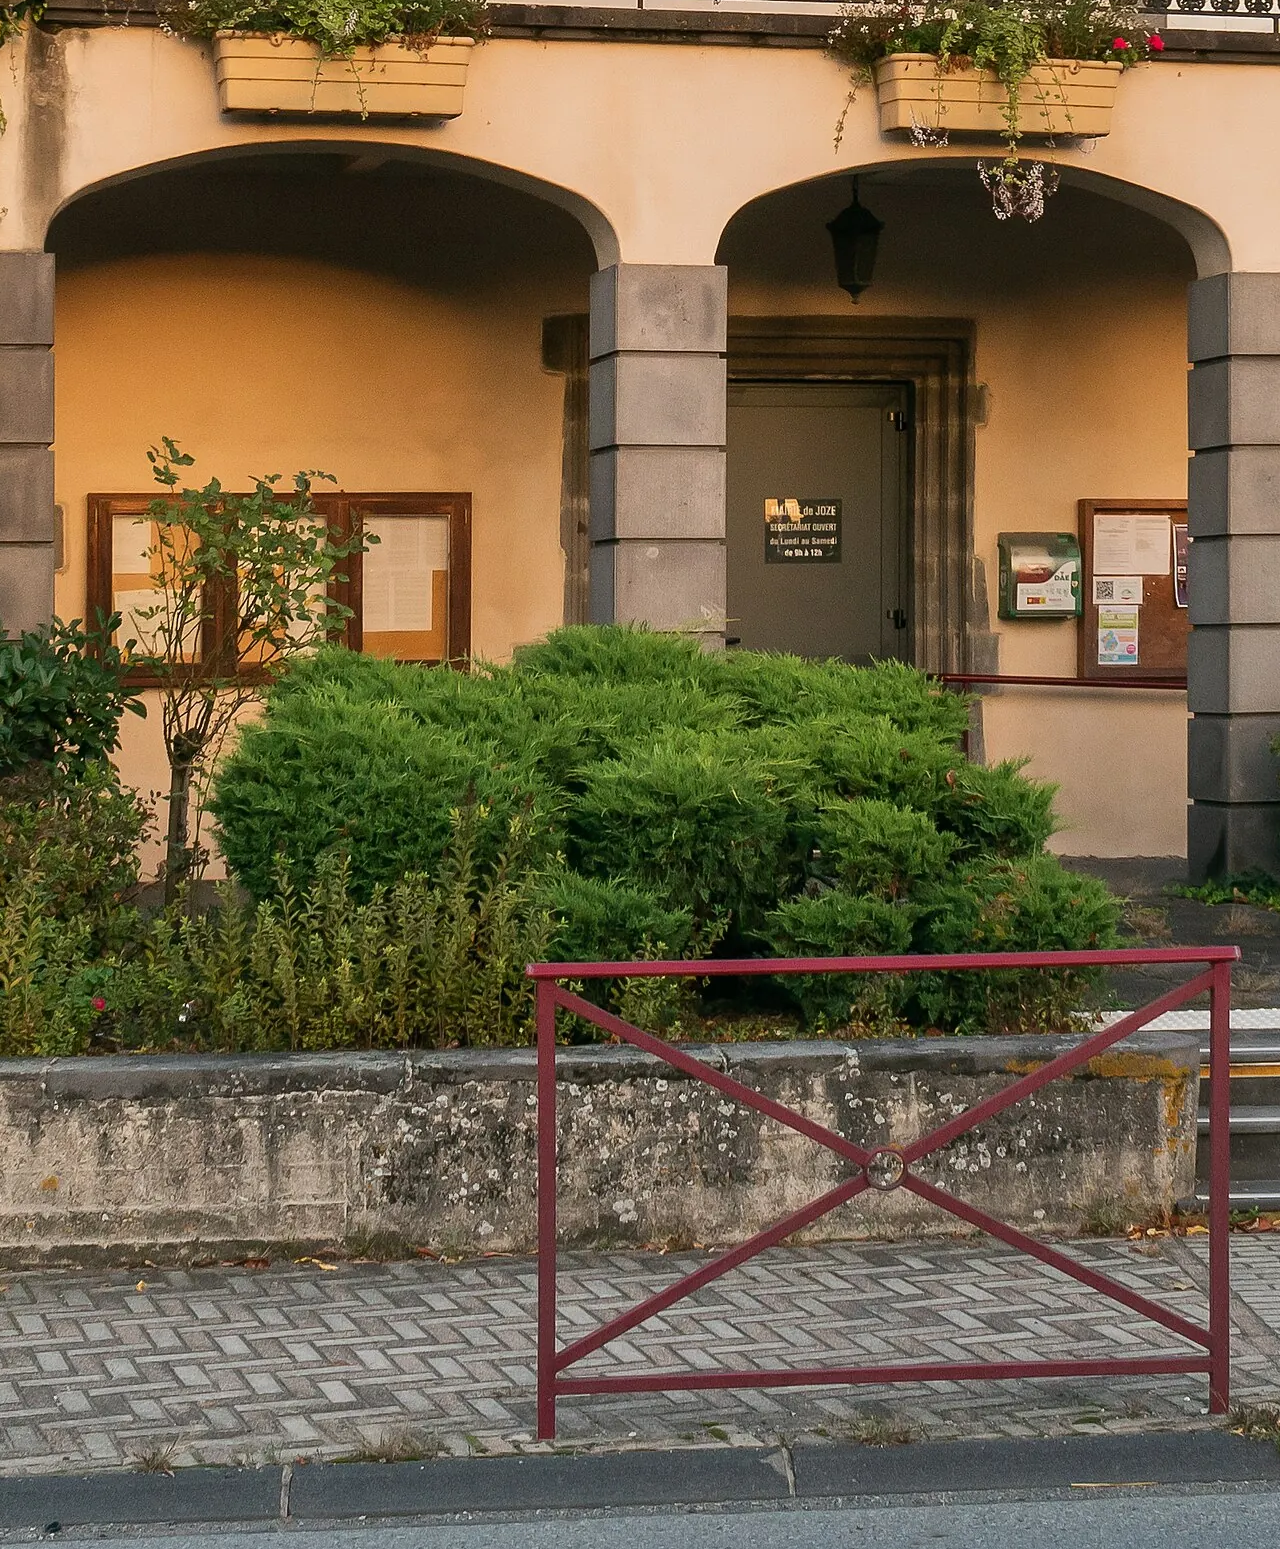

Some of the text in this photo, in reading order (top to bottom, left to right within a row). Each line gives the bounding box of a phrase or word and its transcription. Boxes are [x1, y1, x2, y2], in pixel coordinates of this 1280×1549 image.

[803, 505, 813, 516] de
[815, 505, 836, 516] JOZE
[812, 523, 837, 532] OUVERT
[769, 537, 779, 545] du
[780, 537, 800, 545] Lundi
[811, 536, 837, 545] Samedi
[784, 548, 793, 557] de
[810, 548, 823, 557] 12h
